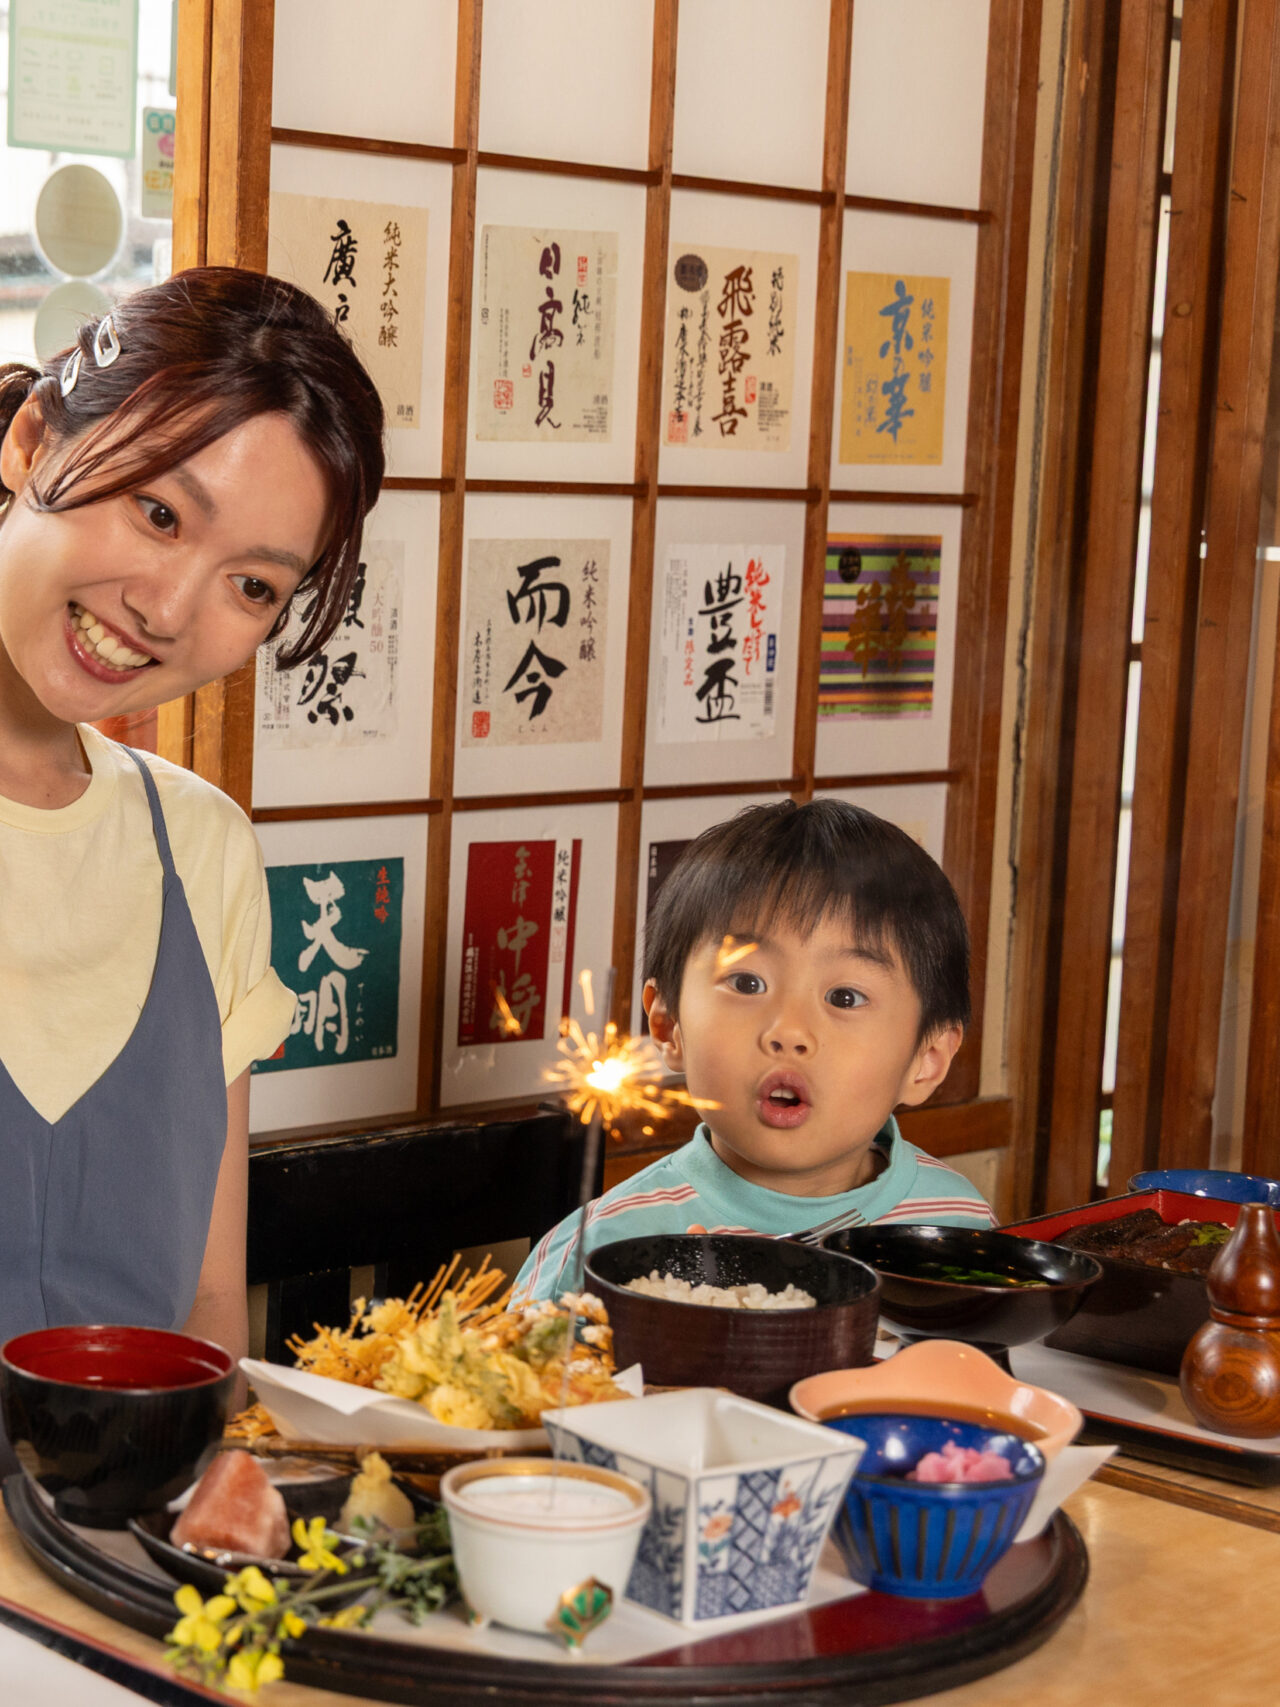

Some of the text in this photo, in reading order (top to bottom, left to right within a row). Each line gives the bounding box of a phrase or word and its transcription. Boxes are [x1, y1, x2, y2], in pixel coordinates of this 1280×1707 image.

[378, 220, 402, 349] 純米大吟醸
[530, 242, 564, 429] 日高見
[711, 264, 757, 438] 飛露喜
[876, 279, 915, 446] 京の華
[502, 555, 569, 722] 而今
[579, 559, 598, 663] 純米吟醸
[289, 869, 371, 1055] 天明
